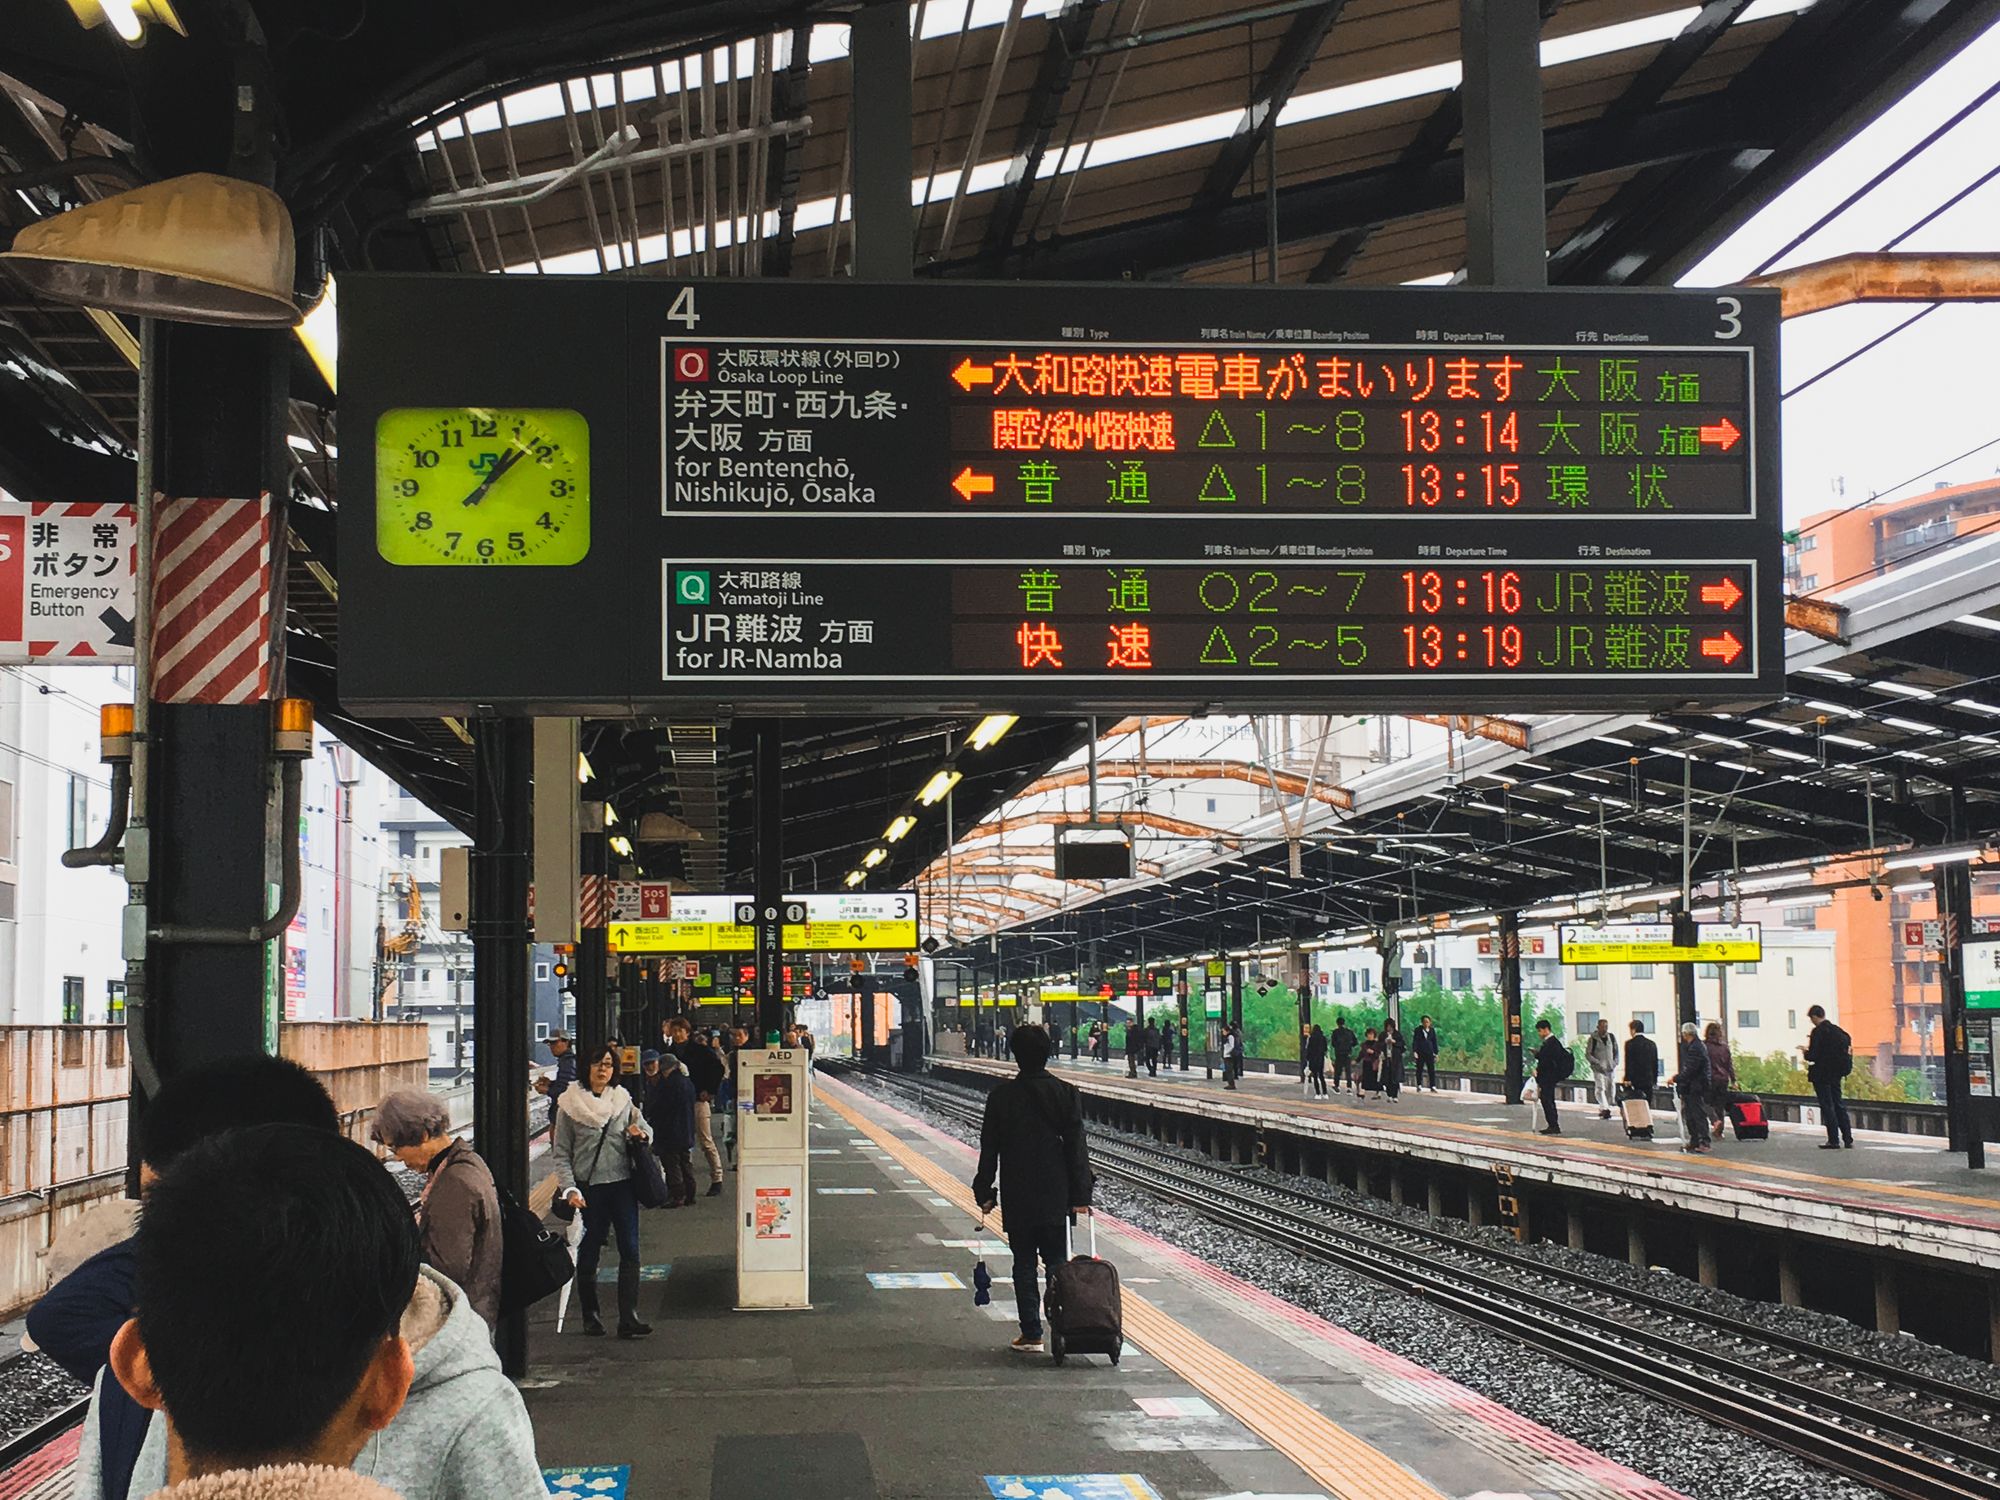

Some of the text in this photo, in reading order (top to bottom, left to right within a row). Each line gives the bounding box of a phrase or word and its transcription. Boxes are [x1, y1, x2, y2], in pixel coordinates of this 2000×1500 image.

[667, 286, 701, 330] 4
[1714, 296, 1743, 340] 3
[1061, 327, 1110, 340] 種別 Type
[1416, 329, 1505, 343] 時刻 Departure Time
[1576, 331, 1649, 342] 行先 Destination
[680, 352, 704, 378] O
[718, 367, 844, 387] Ōsaka Loop Line
[993, 352, 1523, 402] 大和路快速電車がまいります
[469, 419, 498, 438] 12
[675, 422, 813, 453] 大阪 方面
[1401, 410, 1519, 453] 13:14
[440, 429, 464, 448] 11
[413, 449, 440, 469] 10
[535, 445, 554, 464] 2
[674, 455, 856, 481] for Bentenchō,
[401, 479, 419, 498] 9
[550, 479, 568, 498] 3
[675, 479, 876, 508] Nishikujō, Ōsaka
[1401, 464, 1520, 506] 13:15
[415, 511, 433, 530] 8
[535, 511, 554, 530] 4
[445, 532, 463, 550] 7
[476, 538, 494, 557] 6
[507, 532, 525, 550] 5
[1063, 545, 1111, 558] 種別 Type
[1418, 545, 1508, 558] 時刻 Departure Time
[1578, 545, 1652, 557] 行先 Destination
[32, 552, 119, 578] ボタン
[681, 574, 705, 602] Q
[718, 571, 802, 590] 大和路線
[30, 583, 119, 600] Emergency
[718, 592, 824, 609] Yamatoji Line
[1402, 571, 1521, 614] 13:16
[30, 601, 85, 617] Button
[675, 613, 874, 644] JR難波 方面
[1402, 624, 1522, 667] 13:19
[676, 647, 843, 670] for JR-Namba
[643, 889, 666, 899] SOS
[893, 897, 909, 919] 3
[1567, 928, 1578, 944] 2
[768, 1051, 792, 1060] AED
